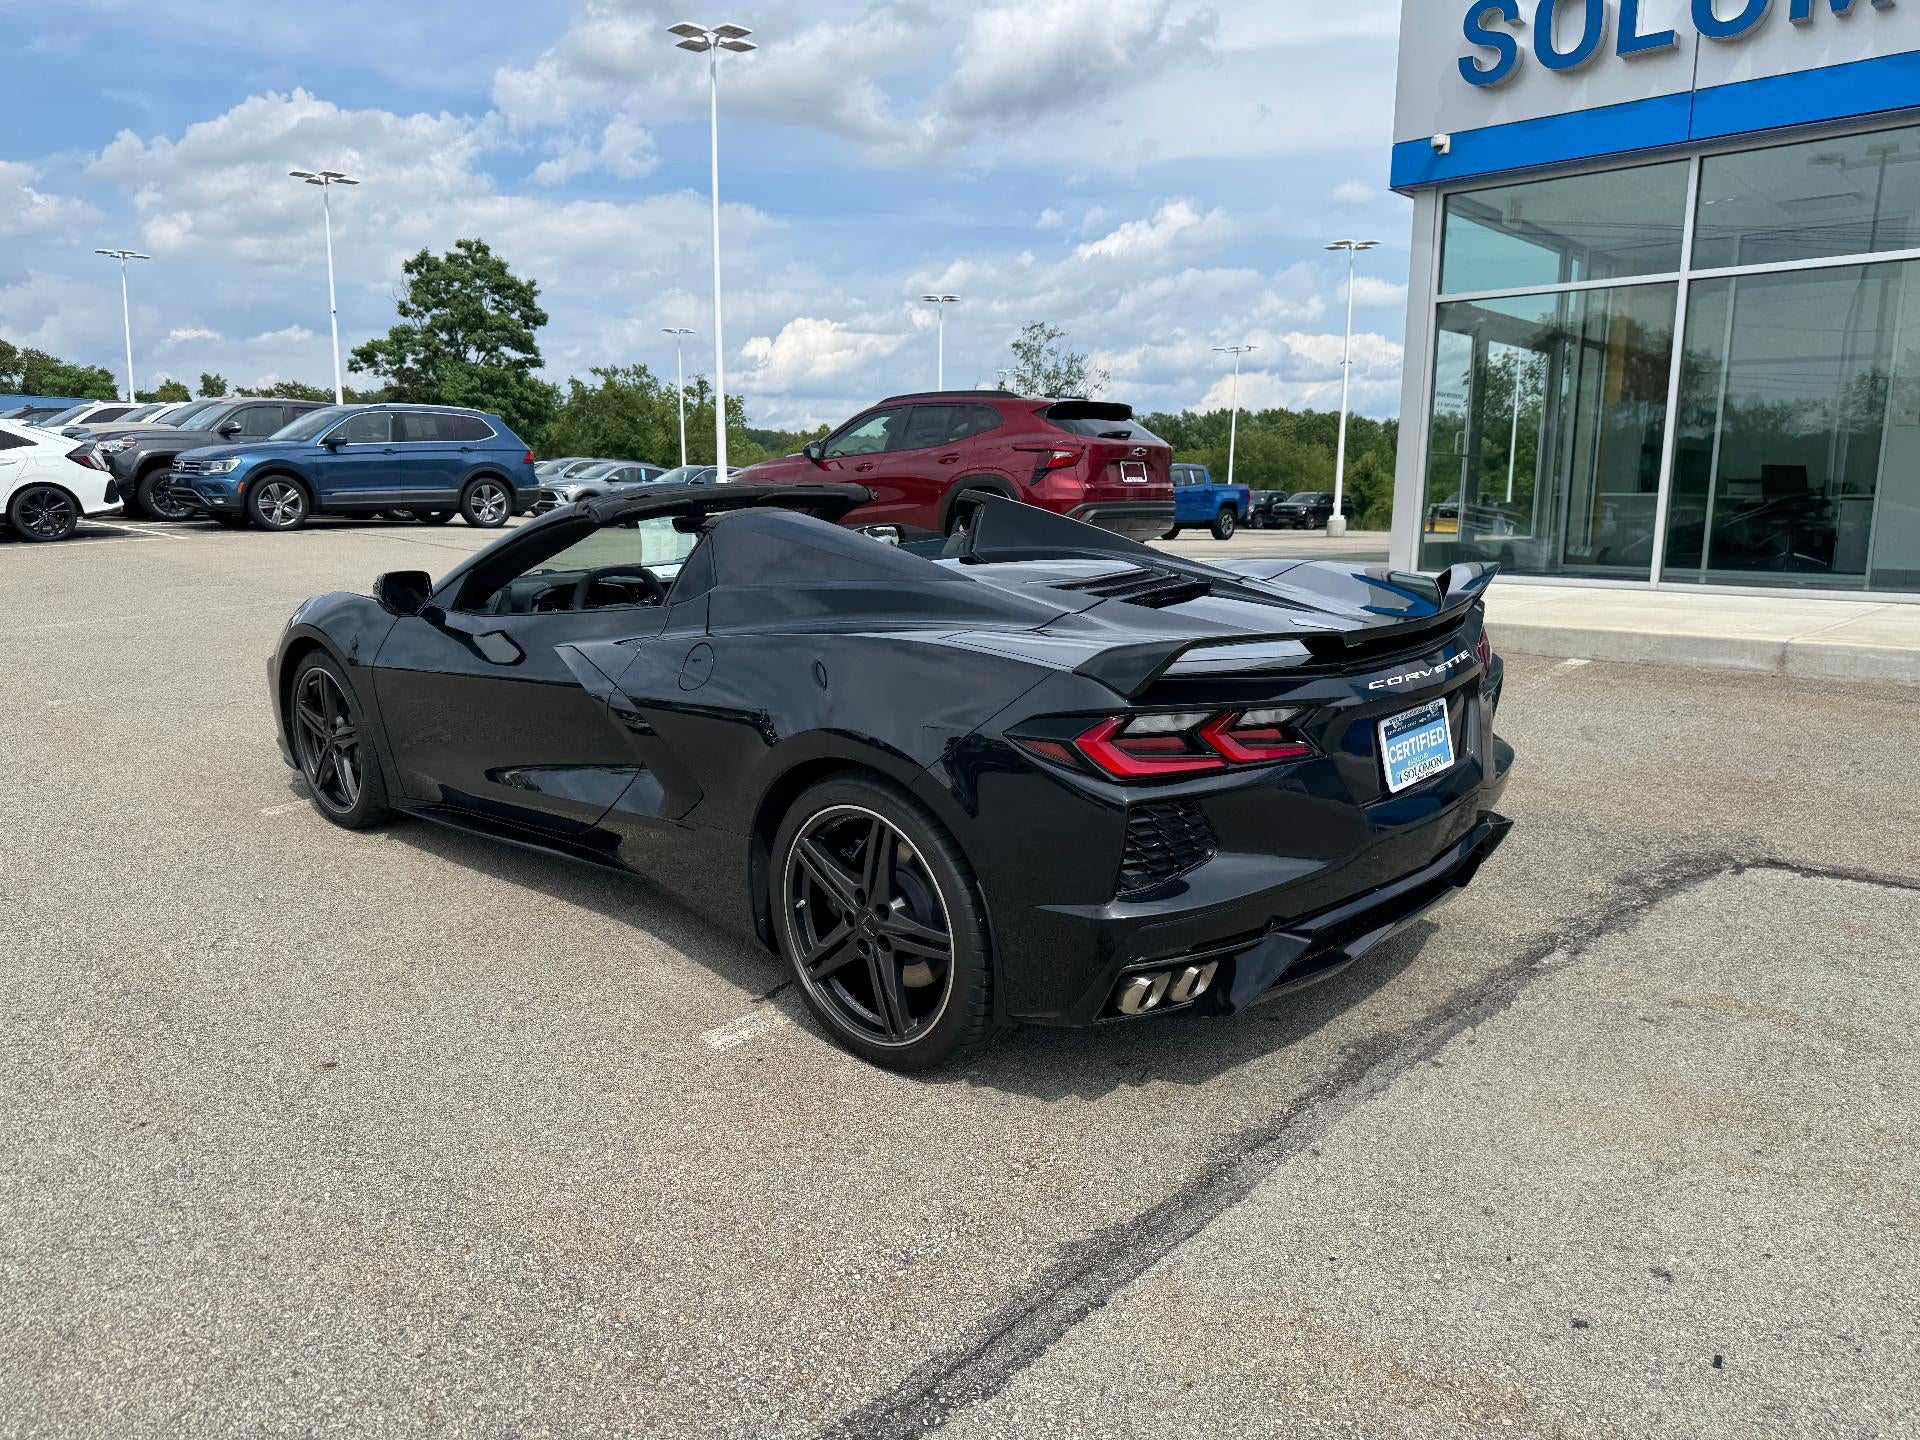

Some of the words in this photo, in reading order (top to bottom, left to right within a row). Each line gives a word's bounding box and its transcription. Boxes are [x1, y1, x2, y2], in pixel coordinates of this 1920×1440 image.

[1458, 0, 1897, 88] SOL
[1368, 649, 1470, 690] CORVETTE
[1388, 726, 1445, 765] CERTIFIED
[1403, 755, 1443, 782] SOLOMON
